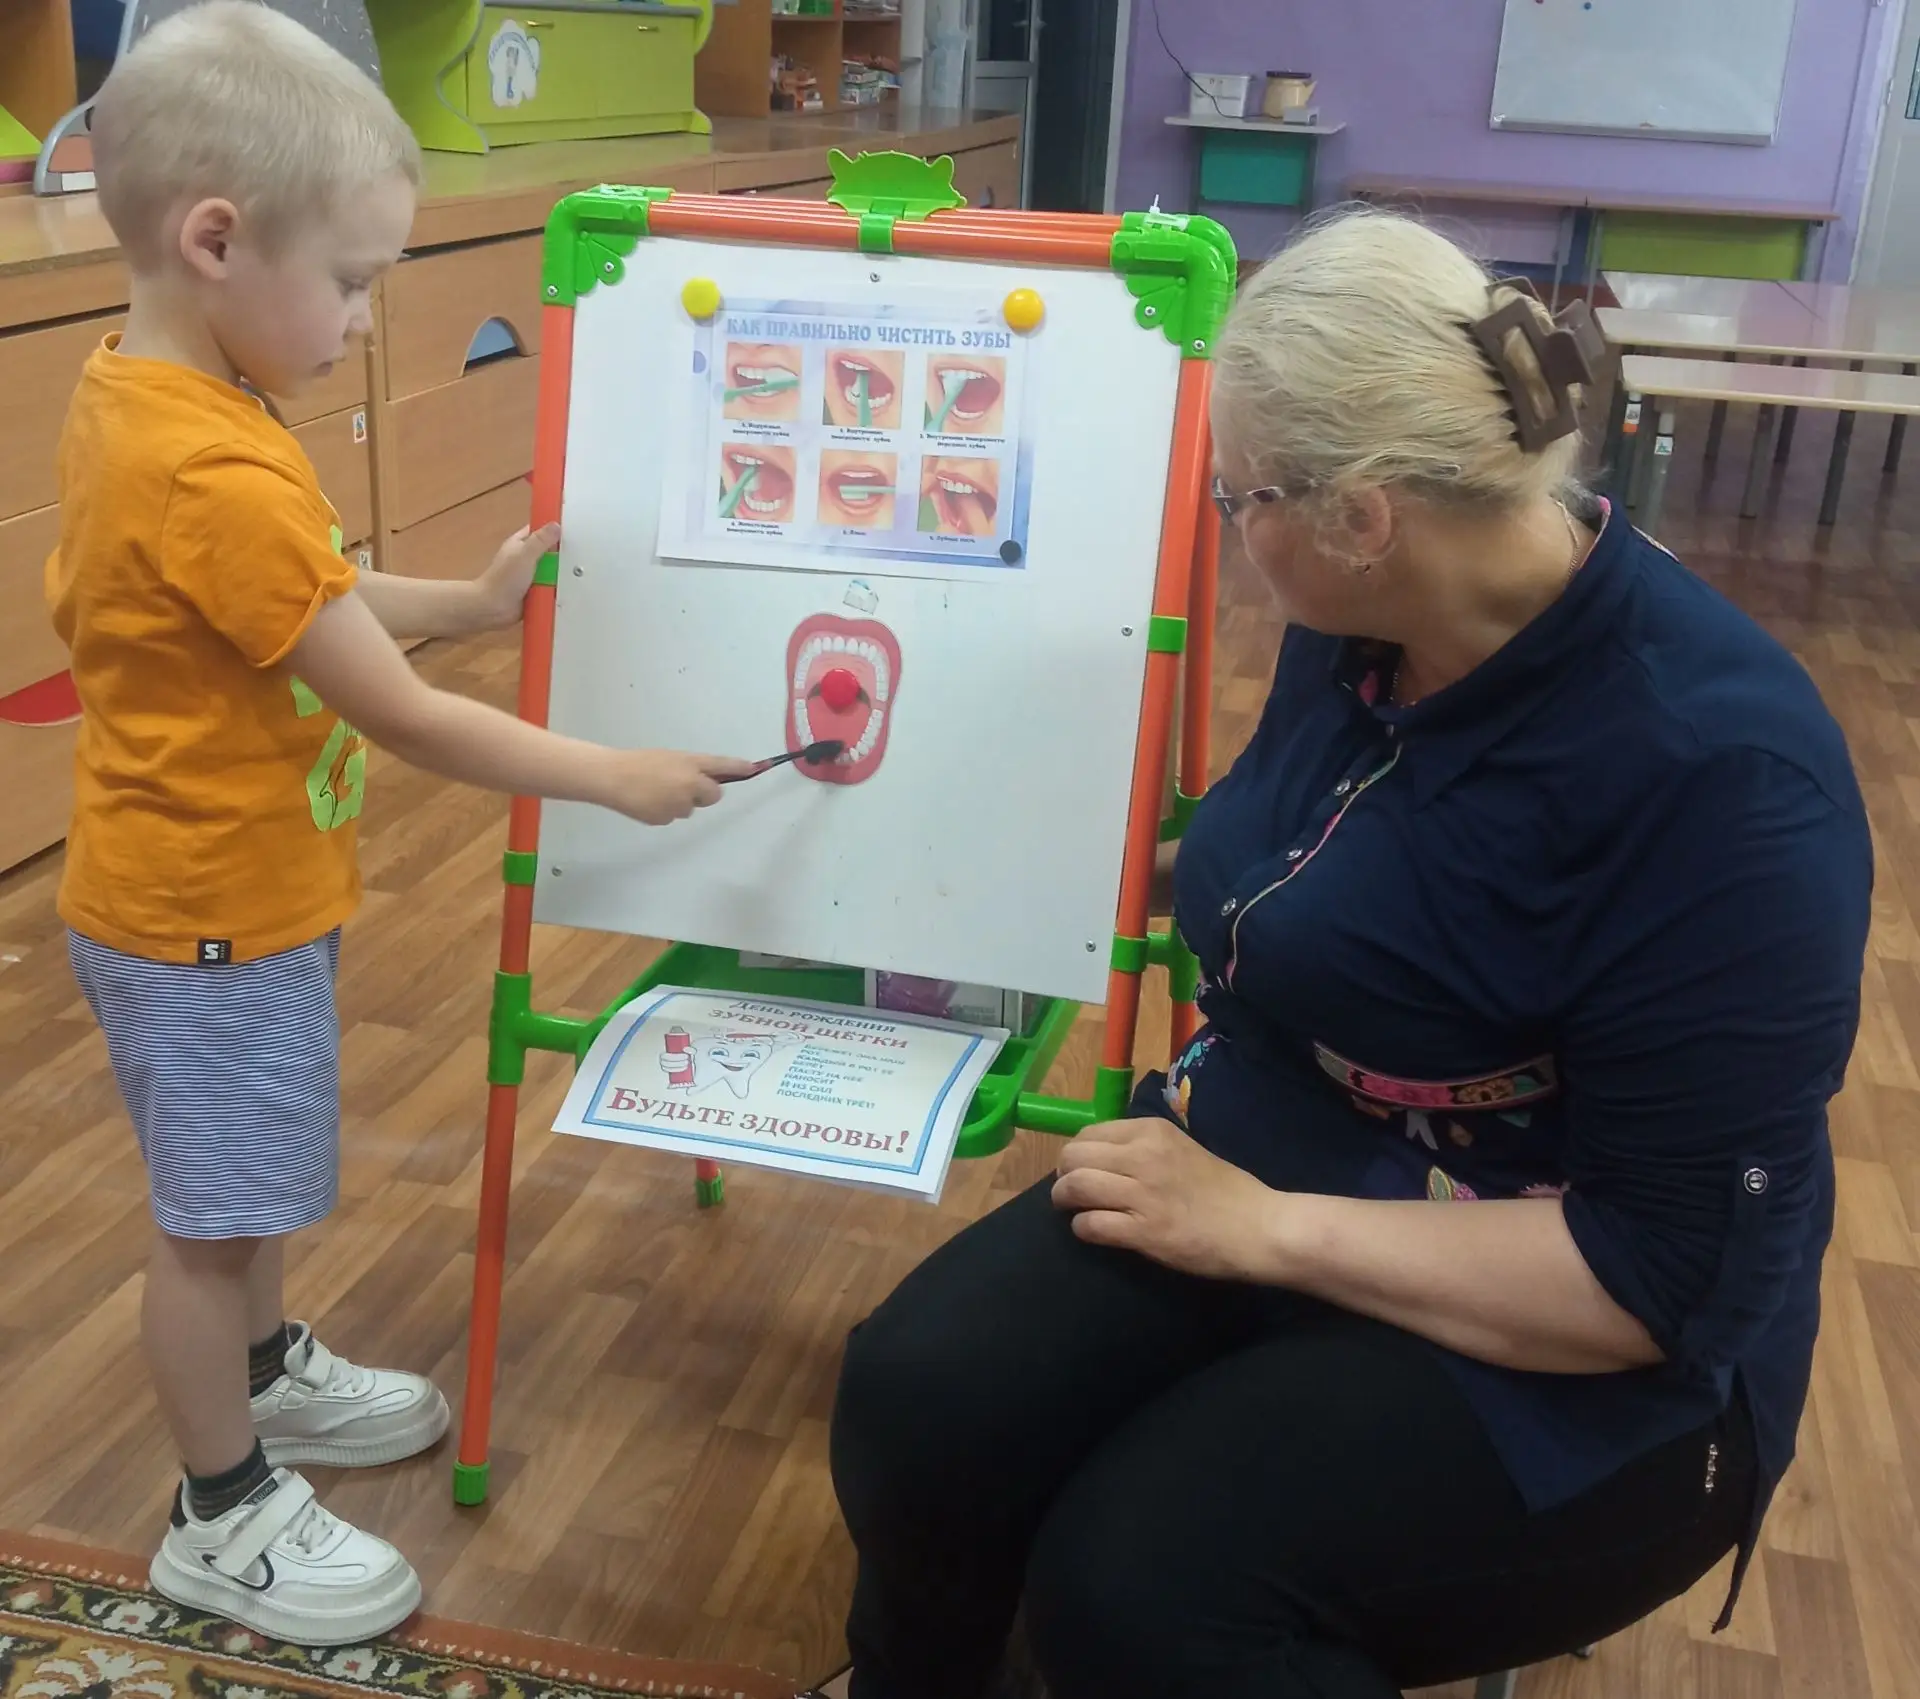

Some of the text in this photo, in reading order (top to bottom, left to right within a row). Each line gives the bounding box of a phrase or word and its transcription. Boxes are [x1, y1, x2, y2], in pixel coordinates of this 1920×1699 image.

[726, 318, 1012, 349] КАК ПРАВИЛЬНО ЧИСТИТЬ ЗУБЫ
[707, 1009, 909, 1049] ЗУБНОЙ ЩЁТКИ
[729, 1000, 897, 1033] ДЕНЬ РОЖДЕНИЯ
[776, 1088, 842, 1105] ПОСЛЕДНИХ
[809, 1085, 833, 1095] СИЛ
